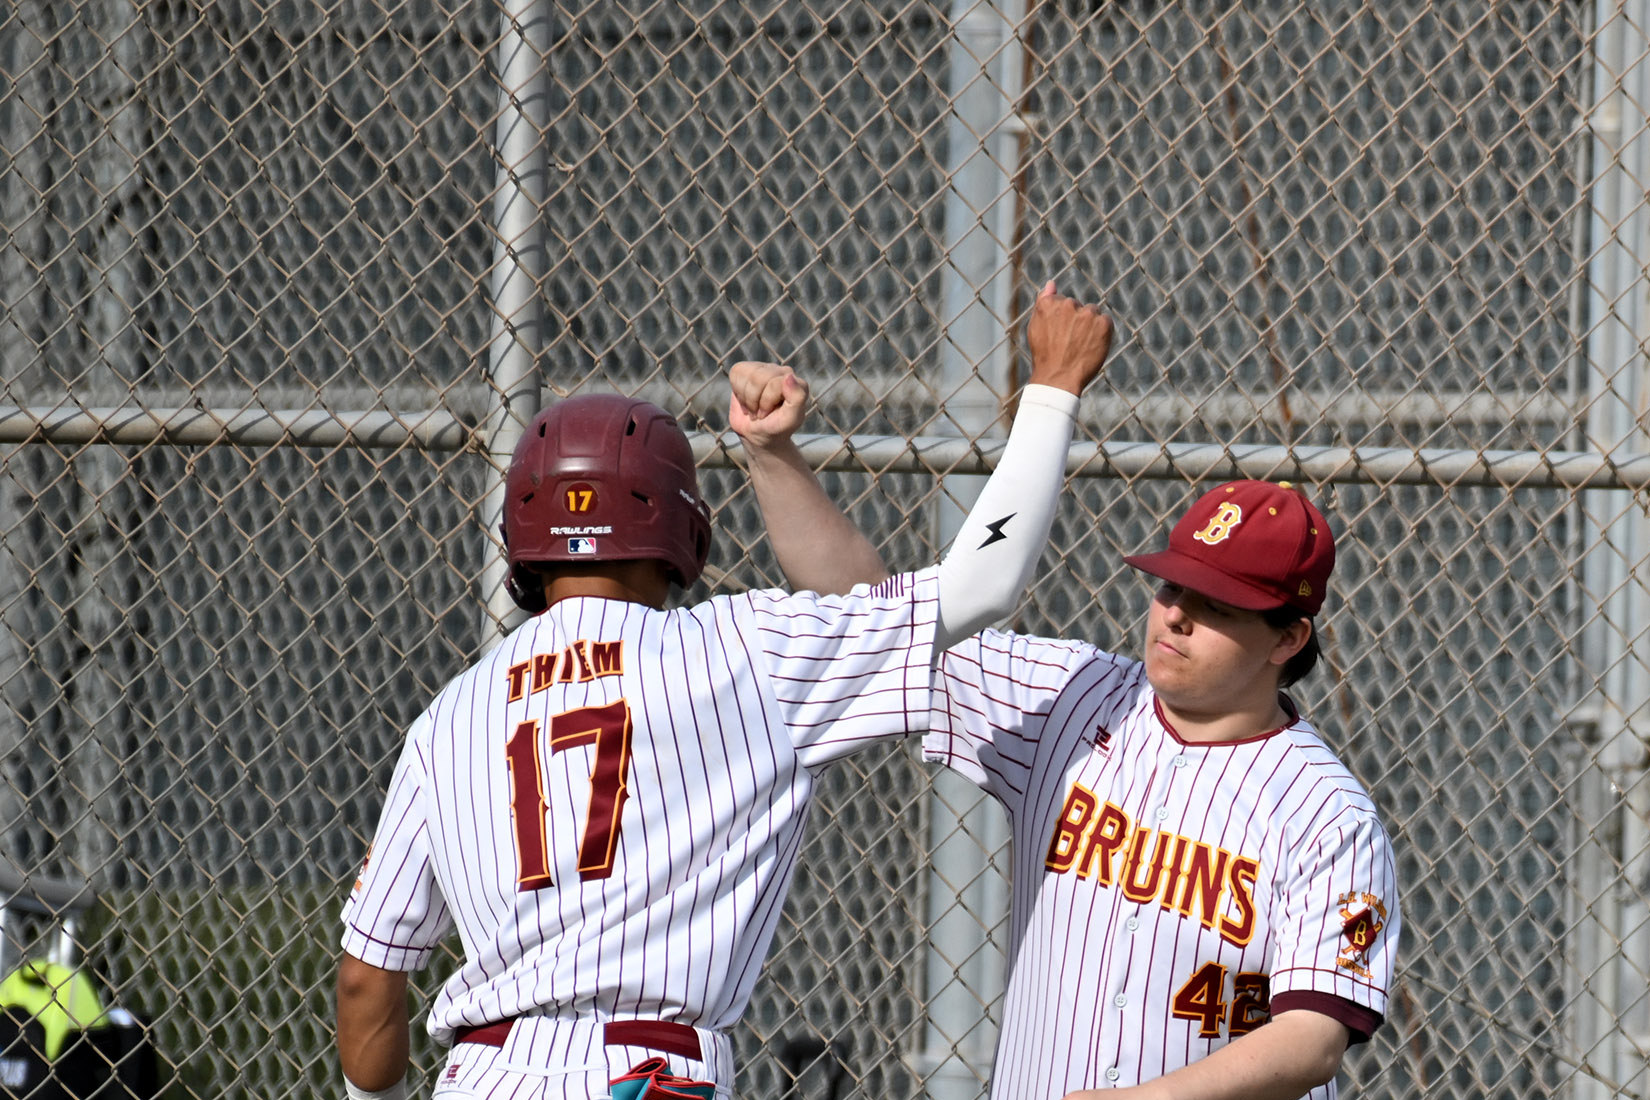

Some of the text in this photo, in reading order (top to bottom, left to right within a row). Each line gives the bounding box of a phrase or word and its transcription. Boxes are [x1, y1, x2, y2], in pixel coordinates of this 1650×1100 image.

[567, 490, 593, 512] 17
[1192, 501, 1242, 546] B
[550, 526, 613, 535] RAWLINGS
[506, 639, 624, 704] THIEM
[505, 696, 634, 893] 17
[1044, 781, 1261, 950] BRUINS
[1353, 919, 1367, 946] B
[1171, 960, 1273, 1044] 42
